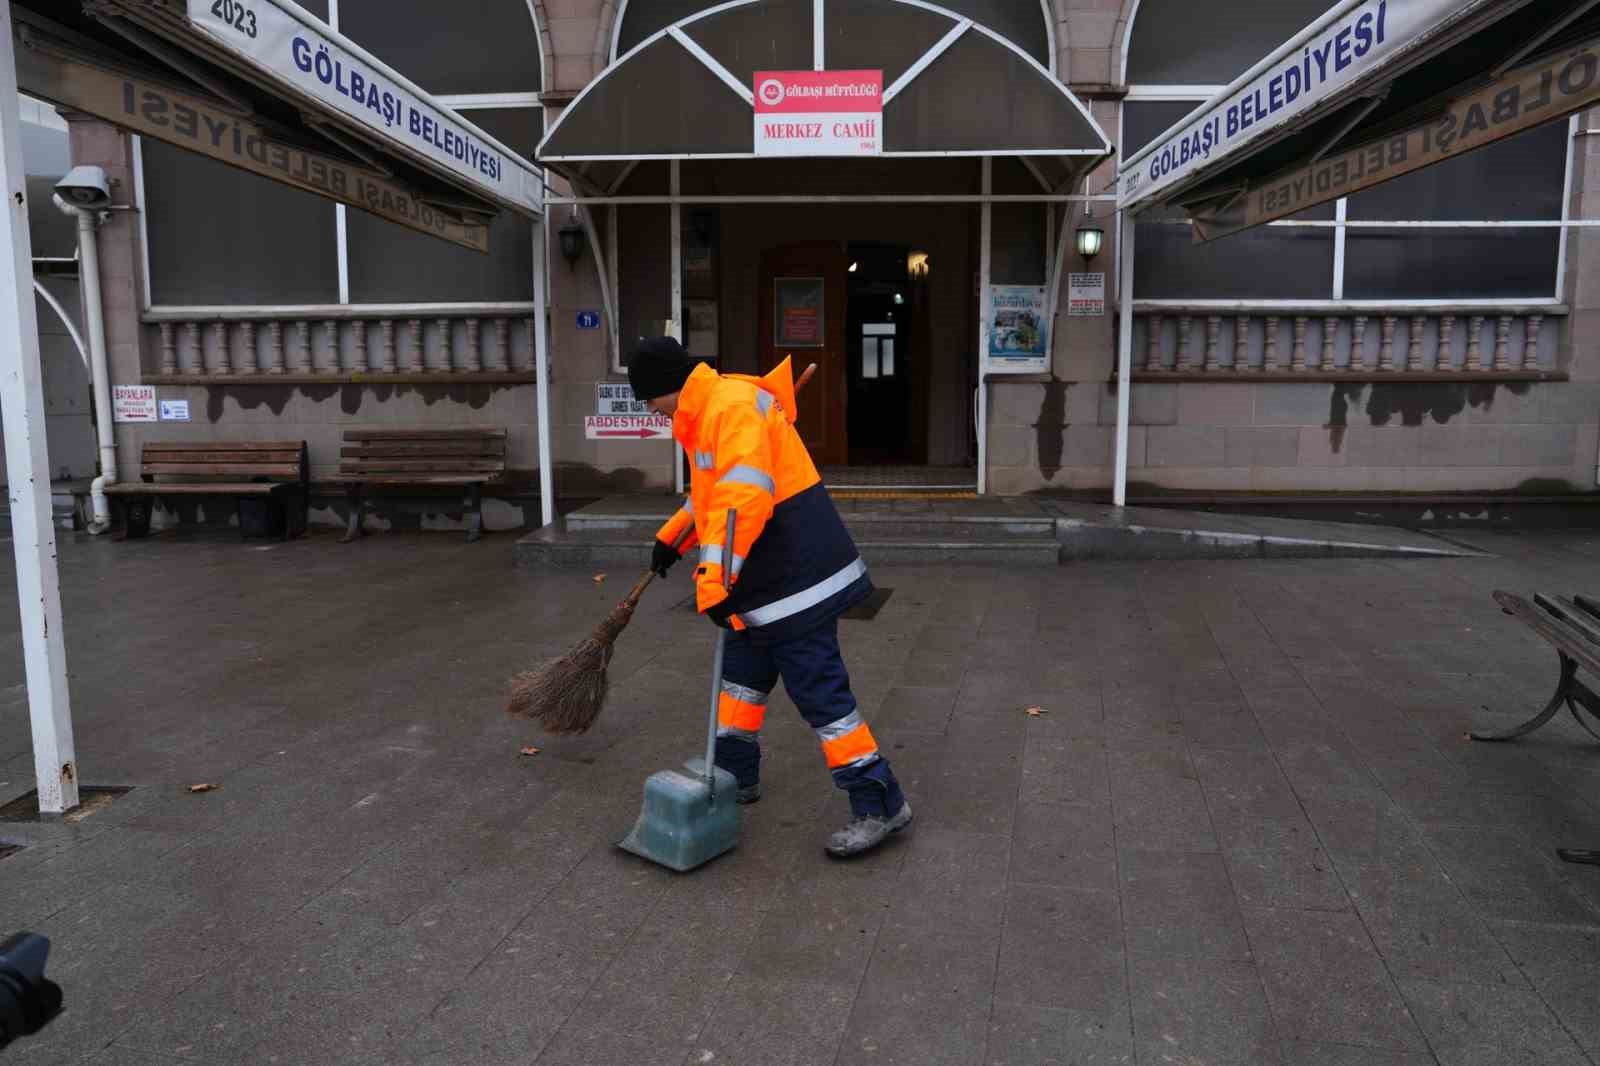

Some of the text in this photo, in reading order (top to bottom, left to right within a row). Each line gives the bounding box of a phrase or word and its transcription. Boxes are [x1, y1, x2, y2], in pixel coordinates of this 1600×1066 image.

[211, 0, 257, 39] 2023
[786, 84, 822, 99] GÖLBAŞI
[1150, 0, 1386, 181] GÖLBAŞI BELEDİYESİ
[292, 36, 502, 182] GÖLBAŞI BELEDİYESİ
[764, 120, 875, 139] MERKEZ CAMİİ
[587, 415, 671, 428] ABDESTHANE
